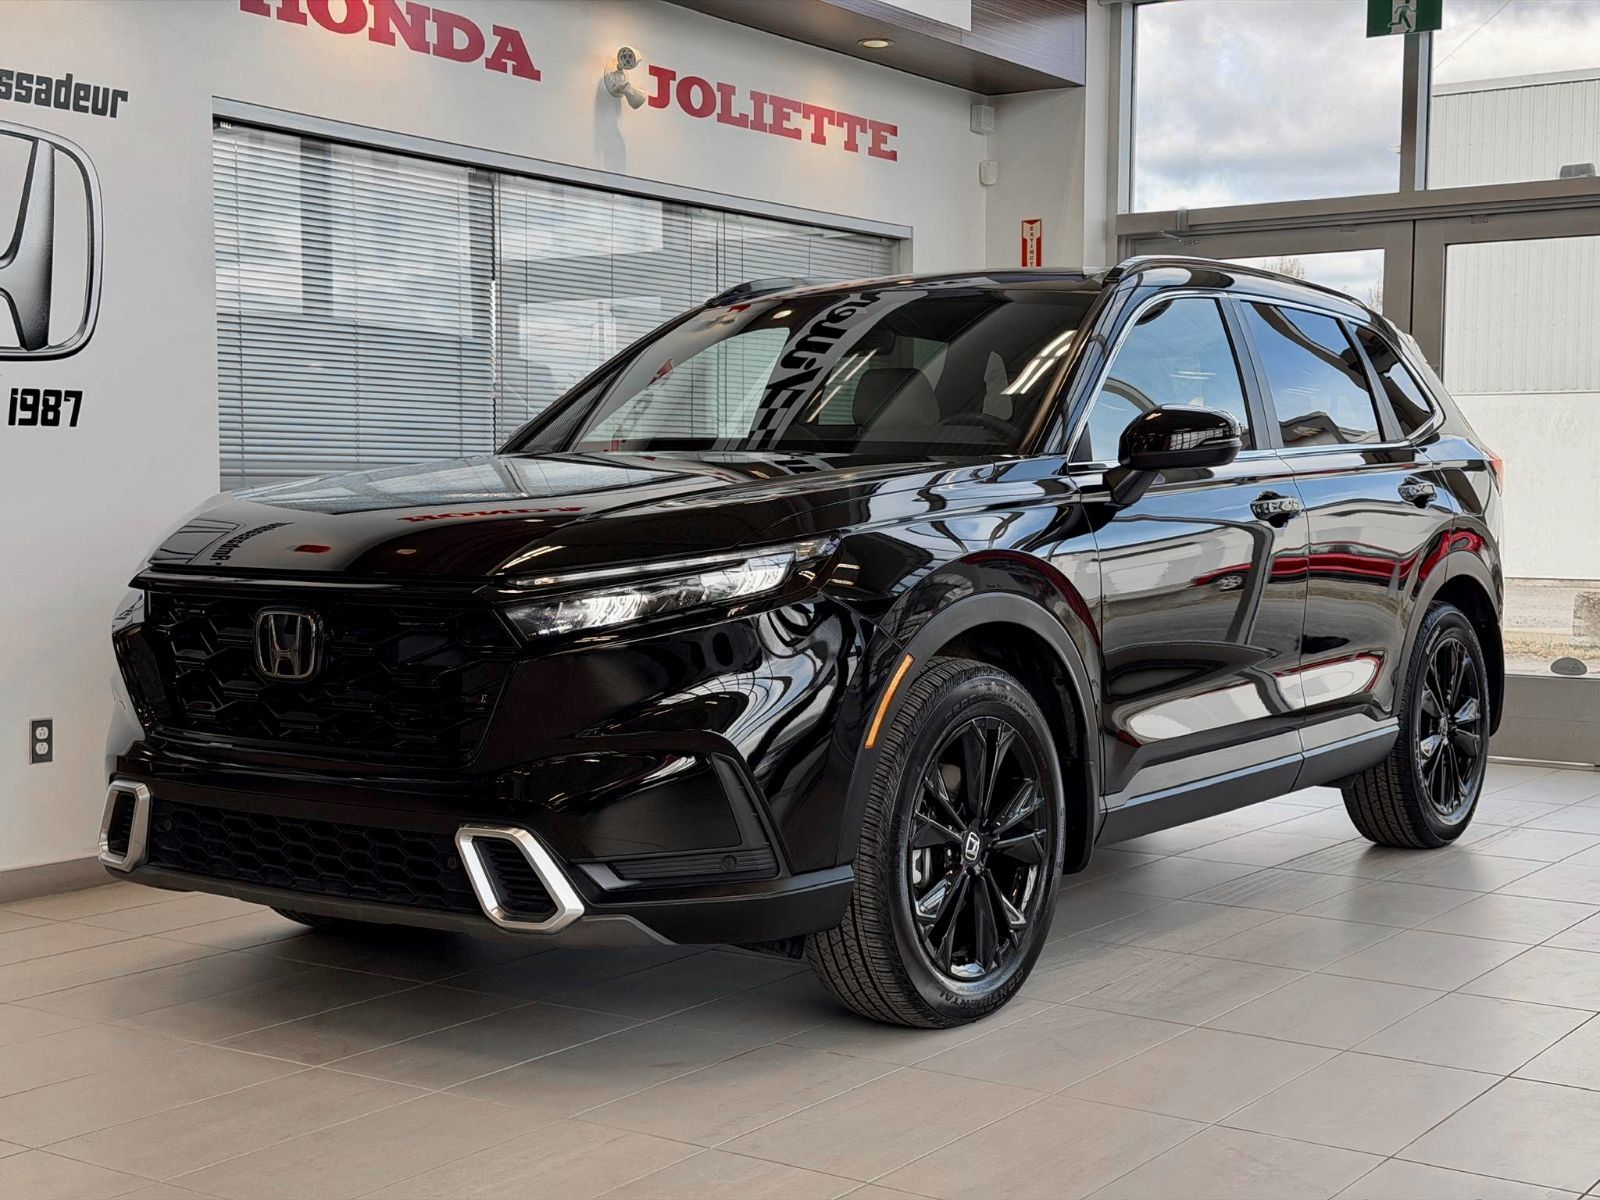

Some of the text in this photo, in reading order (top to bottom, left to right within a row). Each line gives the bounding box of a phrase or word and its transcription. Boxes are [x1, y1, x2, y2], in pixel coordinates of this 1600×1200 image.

[0, 68, 128, 118] ssadeur
[648, 65, 898, 162] JOLIETTE
[8, 387, 83, 427] 1987
